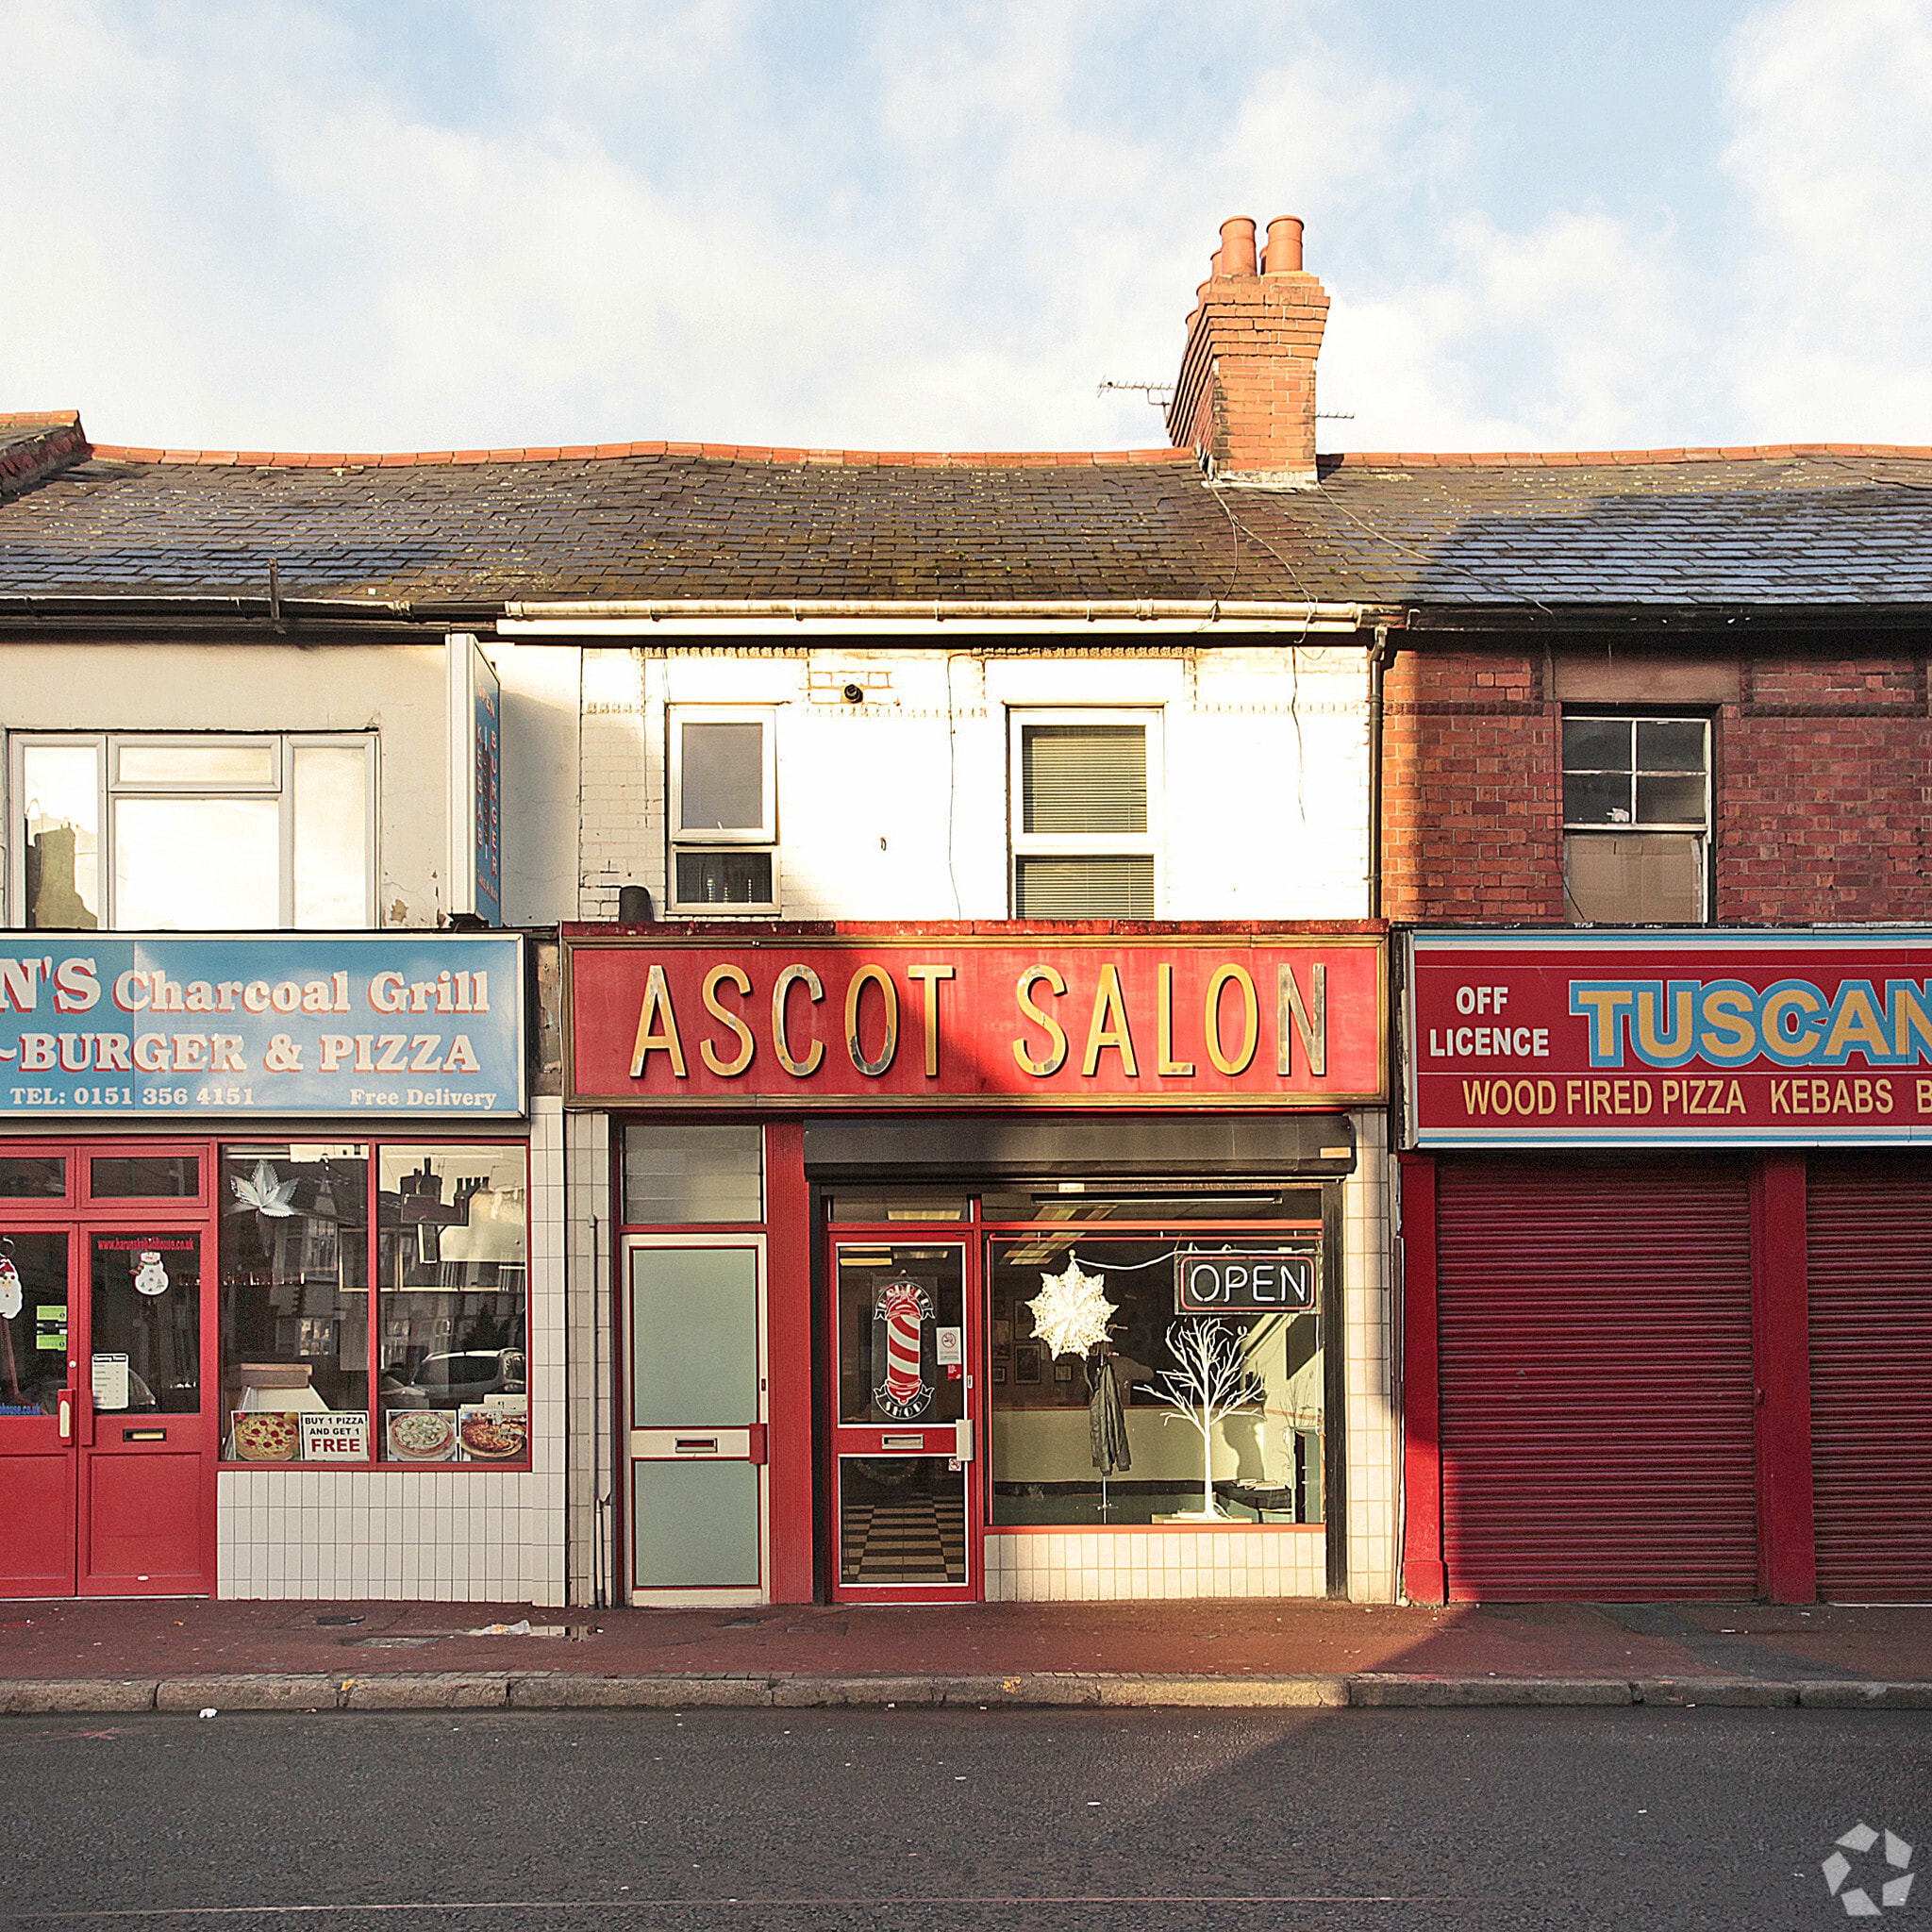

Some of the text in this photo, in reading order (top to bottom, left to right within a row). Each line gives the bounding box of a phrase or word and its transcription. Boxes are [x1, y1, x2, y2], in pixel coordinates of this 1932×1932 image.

[490, 729, 498, 879] BURGER
[112, 970, 351, 1014] Charcoal
[368, 970, 490, 1014] Grill
[1456, 986, 1508, 1015] OFF
[629, 963, 1325, 1077] ASCOT SALON
[1569, 979, 1932, 1068] TUSCAN
[263, 1033, 305, 1074] &
[319, 1034, 481, 1074] PIZZA
[1429, 1027, 1549, 1057] LICENCE
[10, 1087, 497, 1110] TEL: 0151 356 4151 Free Delivery
[1462, 1079, 1557, 1115] WOOD
[1567, 1079, 1653, 1115] FIRED
[1662, 1079, 1747, 1115] PIZZA
[1771, 1078, 1894, 1115] KEBABS
[1191, 1264, 1306, 1303] OPEN
[883, 1401, 923, 1417] SHOP
[311, 1438, 361, 1453] FREE
